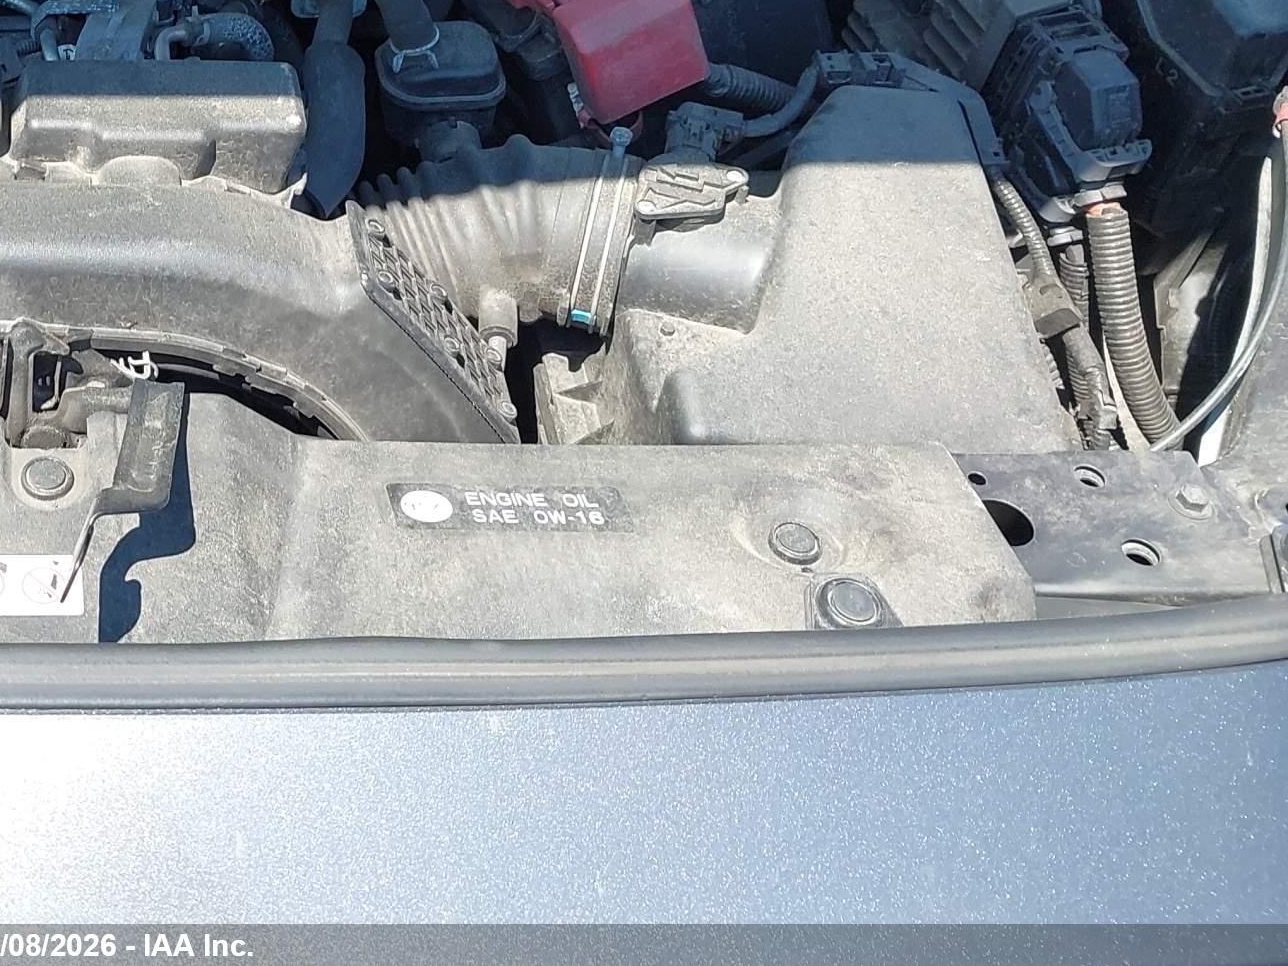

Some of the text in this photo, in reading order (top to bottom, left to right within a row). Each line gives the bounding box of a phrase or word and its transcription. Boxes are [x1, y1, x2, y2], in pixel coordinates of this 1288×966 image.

[463, 490, 600, 509] ENGINE OIL
[471, 508, 520, 524] SAE
